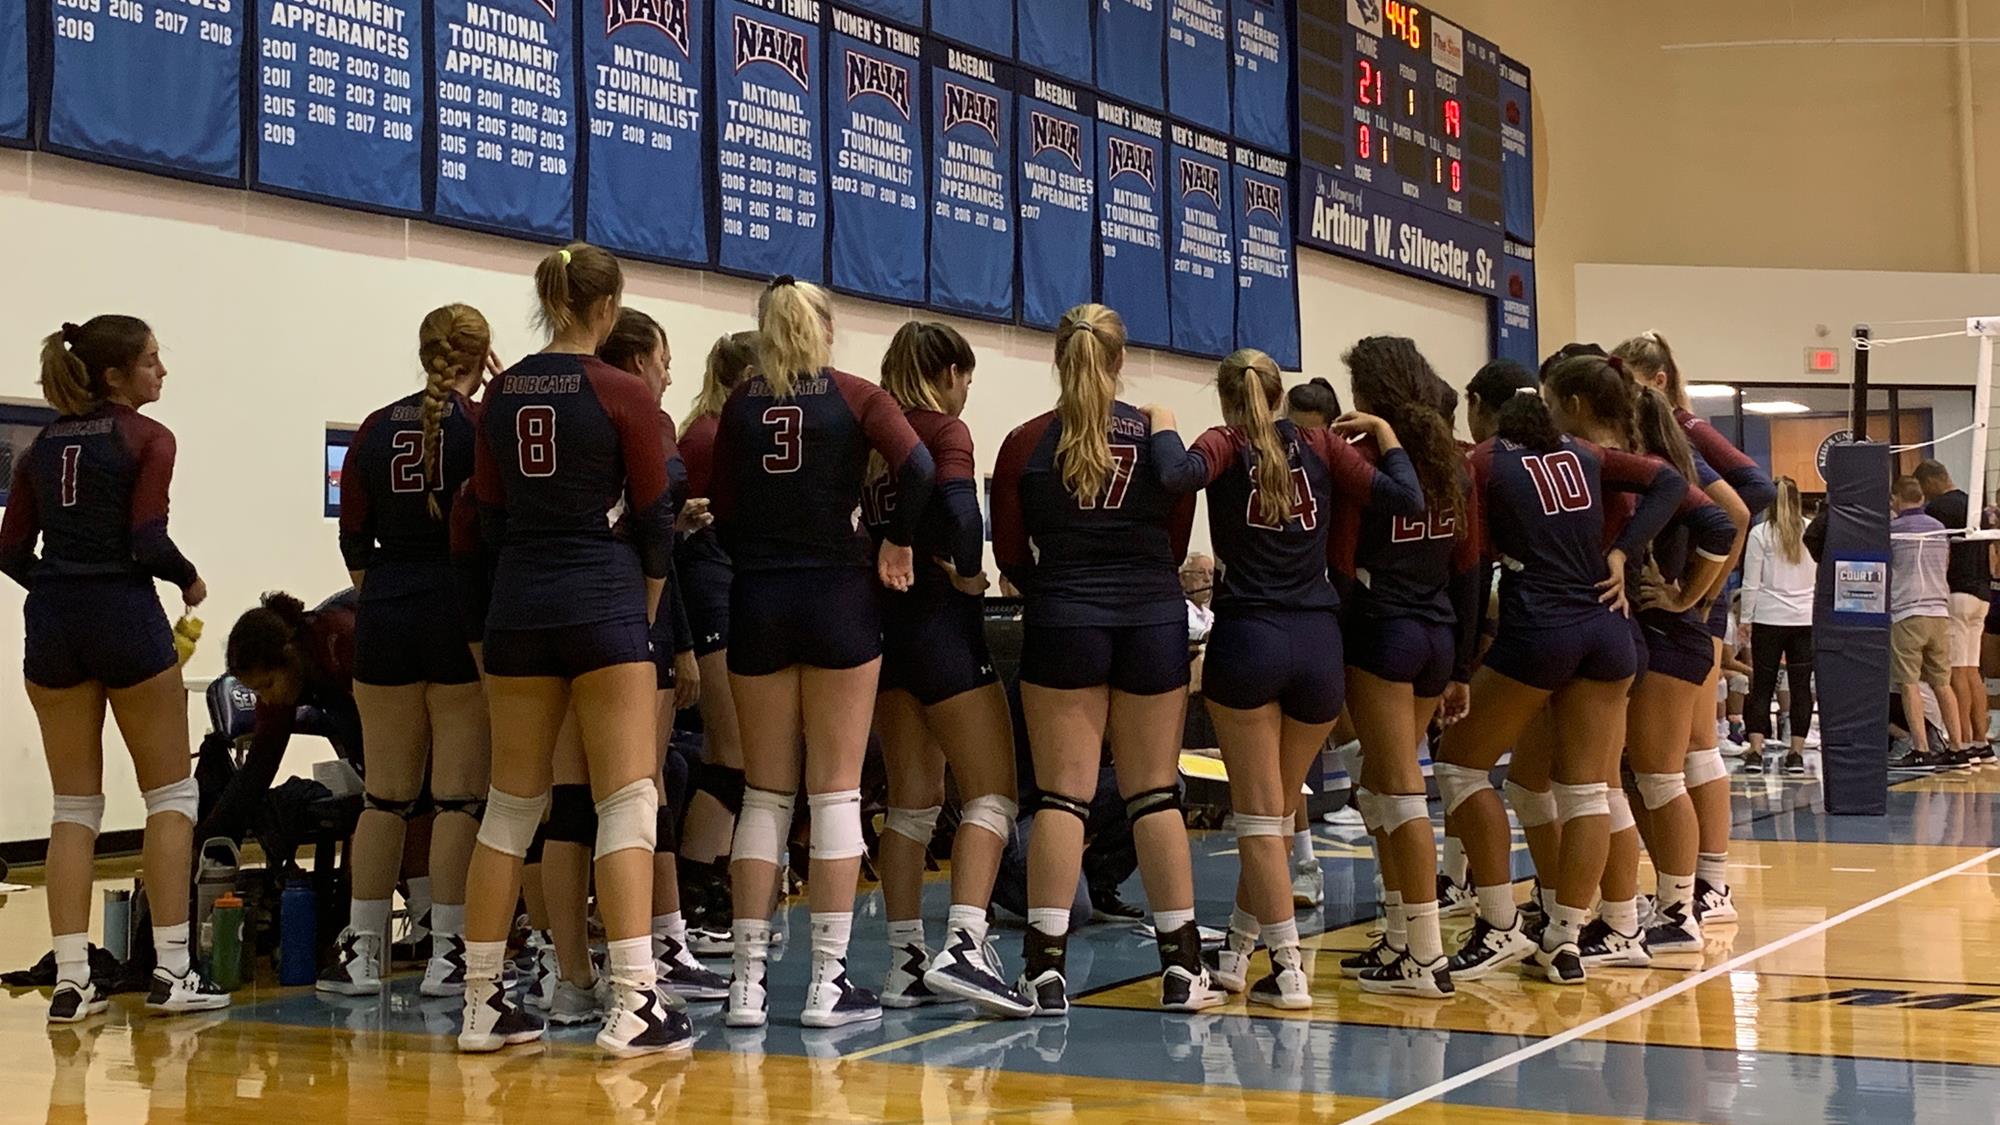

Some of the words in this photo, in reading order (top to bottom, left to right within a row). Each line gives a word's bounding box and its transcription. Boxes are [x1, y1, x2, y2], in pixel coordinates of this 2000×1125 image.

[57, 15, 95, 42] 2019
[108, 0, 144, 23] 2016
[155, 9, 189, 35] 2017
[200, 20, 232, 46] 2018
[467, 2, 548, 44] NATIONAL
[607, 0, 690, 58] NAIA
[781, 0, 820, 23] TENNIS
[1385, 0, 1420, 48] 44.6
[271, 2, 409, 60] APPEARANCES
[448, 23, 559, 73] TOURNAMENT
[832, 6, 881, 44] WOMEN'S
[884, 26, 920, 57] TENNIS
[263, 38, 296, 61] 2001
[309, 46, 340, 71] 2002
[347, 56, 379, 81] 2003
[384, 66, 410, 89] 2010
[614, 44, 683, 82] NATIONAL
[734, 15, 809, 91] NAIA
[948, 48, 995, 83] BASEBALL
[264, 66, 290, 88] 2011
[308, 74, 335, 97] 2012
[346, 83, 375, 106] 2013
[383, 92, 411, 115] 2014
[445, 50, 561, 99] APPEARANCES
[596, 64, 698, 108] TOURNAMENT
[846, 50, 910, 120] NAIA
[1360, 60, 1381, 105] 21
[440, 81, 471, 103] 2000
[477, 89, 503, 110] 2001
[511, 97, 538, 120] 2002
[542, 106, 567, 127] 2003
[594, 89, 699, 131] SEMIFINALIST
[742, 81, 804, 115] NATIONAL
[1034, 78, 1077, 111] BASEBALL
[264, 94, 295, 117] 2015
[308, 103, 336, 125] 2016
[346, 111, 375, 134] 2017
[384, 120, 413, 142] 2018
[440, 107, 471, 129] 2004
[477, 115, 506, 136] 2005
[511, 123, 537, 144] 2006
[540, 130, 565, 150] 2013
[590, 118, 614, 137] 2017
[622, 124, 645, 144] 2018
[651, 131, 672, 150] 2019
[727, 100, 811, 139] TOURNAMENT
[852, 111, 905, 144] NATIONAL
[944, 82, 999, 148] NAIA
[1097, 100, 1130, 128] WOMEN'S
[1131, 111, 1162, 139] LACROSSE
[264, 123, 295, 146] 2019
[724, 122, 812, 161] APPEARANCES
[841, 128, 912, 166] TOURNAMENT
[1031, 111, 1082, 172] NAIA
[1171, 124, 1193, 148] MEN'S
[1194, 132, 1228, 160] LACROSSE
[1360, 124, 1370, 158] 0
[440, 133, 466, 154] 2015
[477, 140, 502, 161] 2016
[511, 148, 534, 168] 2017
[540, 155, 567, 175] 2018
[442, 159, 466, 180] 2019
[720, 150, 745, 168] 2002
[750, 156, 772, 174] 2003
[775, 161, 796, 179] 2004
[838, 150, 912, 187] SEMIFINALIST
[948, 141, 994, 169] NATIONAL
[1109, 137, 1156, 192] NAIA
[1235, 146, 1255, 169] MEN'S
[721, 172, 745, 191] 2006
[750, 178, 772, 196] 2009
[832, 175, 857, 193] 2003
[940, 157, 1003, 191] TOURNAMENT
[1024, 161, 1057, 186] WORLD
[1058, 172, 1094, 195] SERIES
[1180, 158, 1222, 211] NAIA
[1451, 161, 1460, 192] 0
[722, 195, 742, 213] 2014
[749, 201, 769, 218] 2015
[797, 211, 816, 228] 2017
[940, 177, 1004, 211] APPEARANCES
[1021, 204, 1040, 220] 2017
[1031, 182, 1088, 212] APPEARANCE
[1113, 188, 1152, 212] NATIONAL
[1244, 178, 1283, 227] NAIA
[750, 223, 769, 240] 2019
[1105, 203, 1159, 231] TOURNAMENT
[1181, 221, 1227, 248] TOURNAMENT
[1185, 206, 1218, 230] NATIONAL
[1179, 238, 1231, 265] APPEARANCES
[1312, 196, 1369, 252] Arthur
[1373, 214, 1395, 260] W.
[1399, 223, 1472, 287] Silvester,
[1476, 247, 1496, 289] Sr.
[502, 374, 582, 395] BOBCATS
[516, 405, 557, 478] 8
[762, 405, 803, 474] 3
[61, 445, 82, 507] 1
[1078, 445, 1138, 510] 7
[1521, 450, 1592, 516] 10
[1840, 570, 1873, 581] COURT
[1877, 571, 1882, 581] 1
